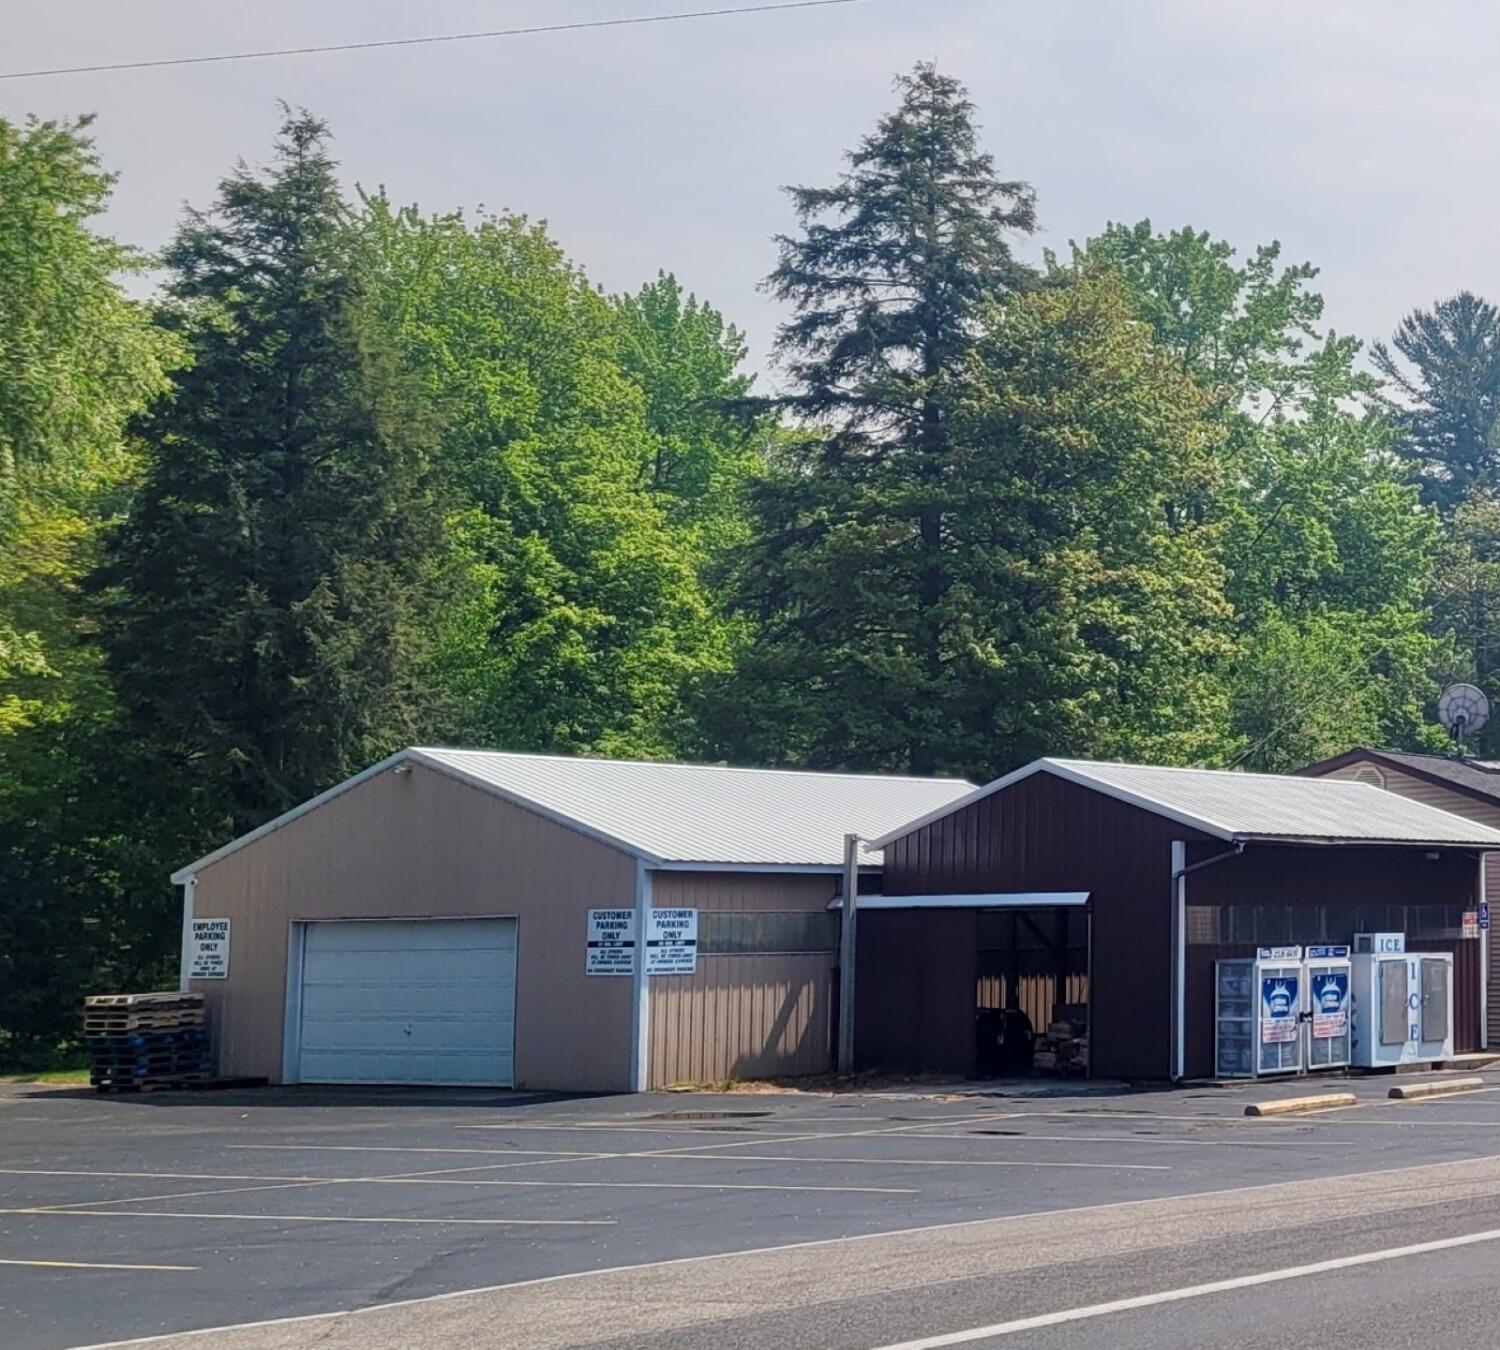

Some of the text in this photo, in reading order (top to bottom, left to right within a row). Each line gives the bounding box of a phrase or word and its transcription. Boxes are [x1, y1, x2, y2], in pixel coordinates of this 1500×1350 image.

[593, 911, 632, 920] CUSTOMER
[653, 910, 693, 919] CUSTOMER
[193, 922, 228, 931] EMPLOYEE
[596, 921, 628, 930] PARKING
[656, 920, 690, 929] PARKING
[195, 932, 225, 940] PARKING
[602, 931, 620, 940] ONLY
[663, 930, 682, 939] ONLY
[200, 943, 218, 952] ONLY
[1380, 938, 1401, 952] ICE
[1409, 962, 1420, 1041] ICE
